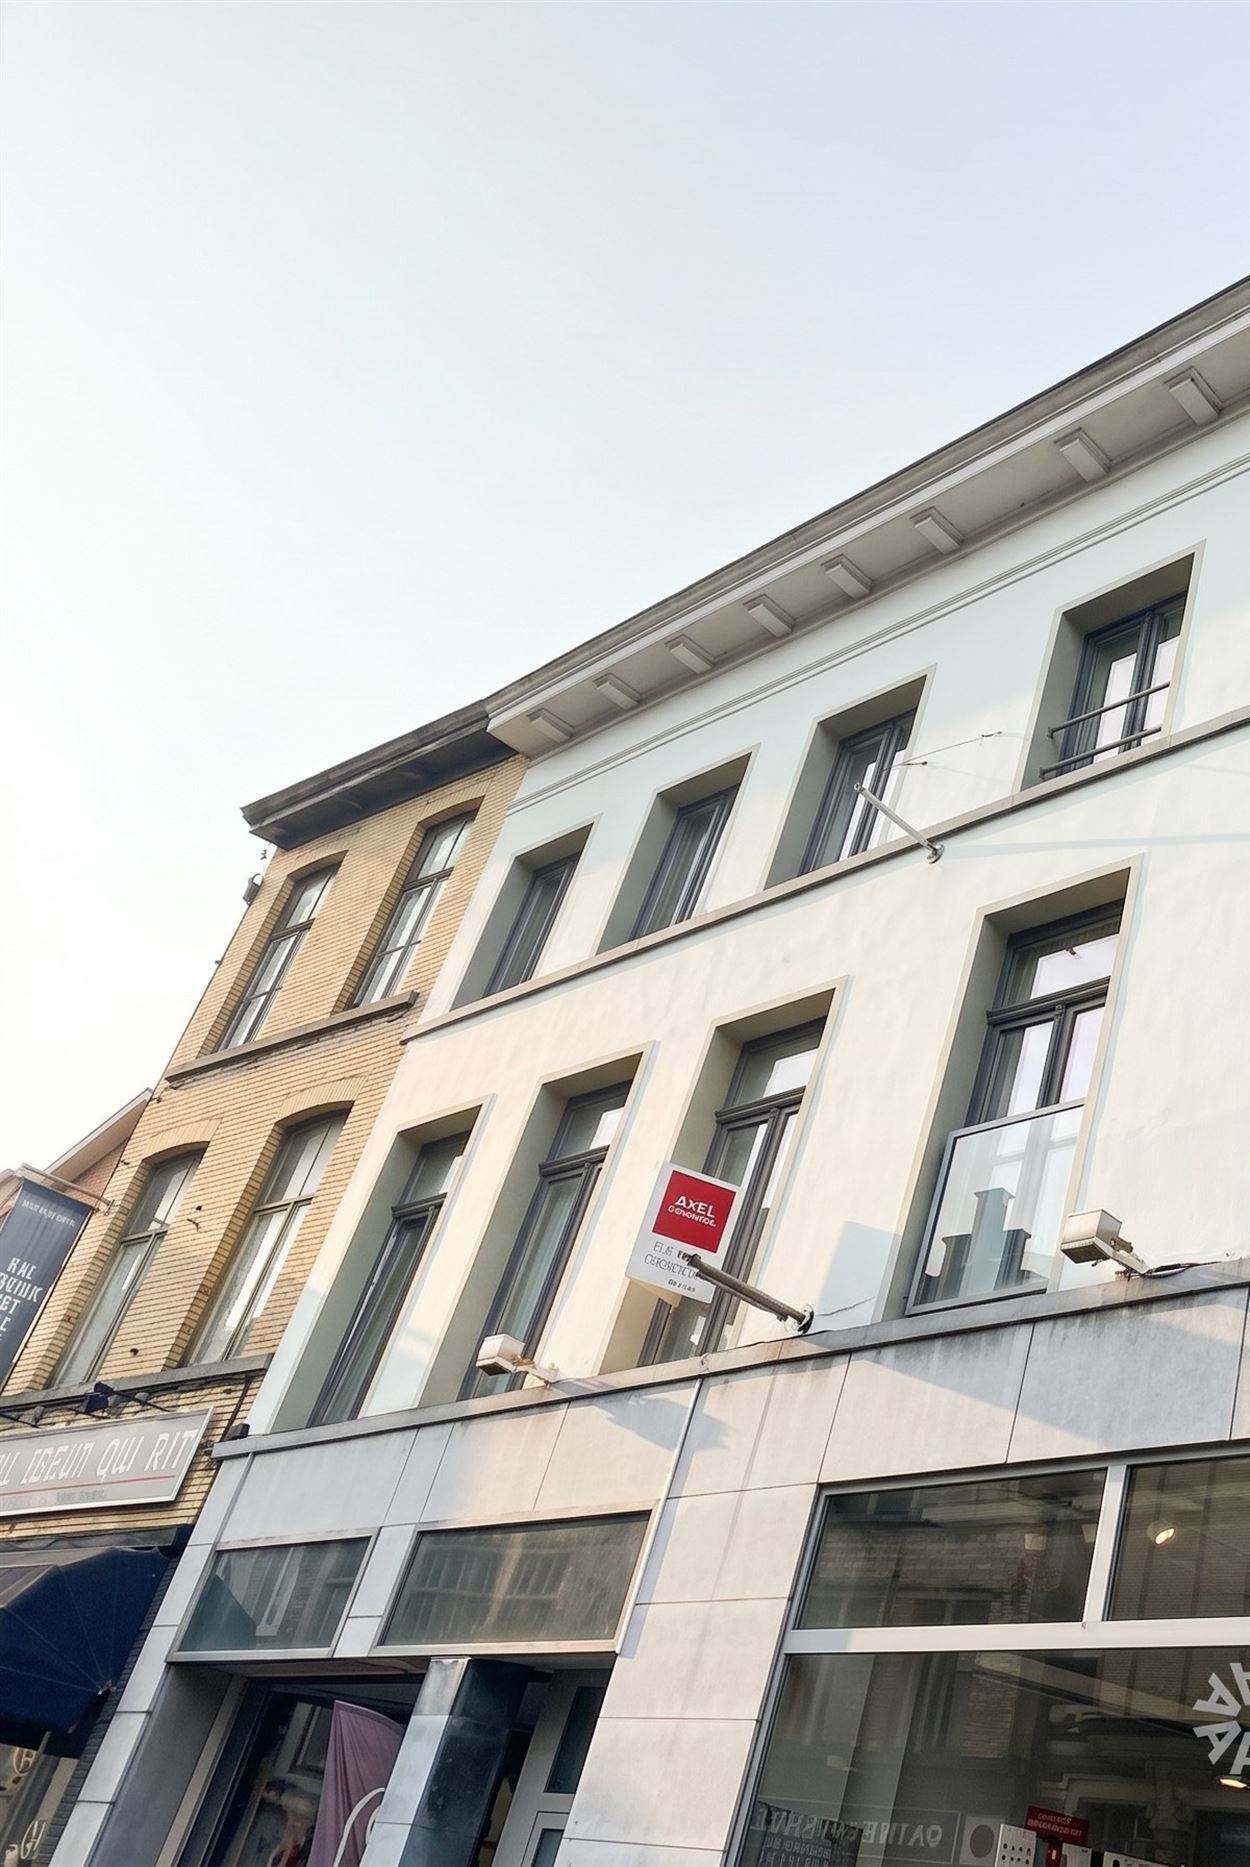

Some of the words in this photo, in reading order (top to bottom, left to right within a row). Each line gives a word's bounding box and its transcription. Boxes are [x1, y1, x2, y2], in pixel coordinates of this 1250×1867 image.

[674, 1195, 716, 1218] AXEL
[96, 1435, 145, 1484] QUI
[144, 1428, 200, 1473] RIT
